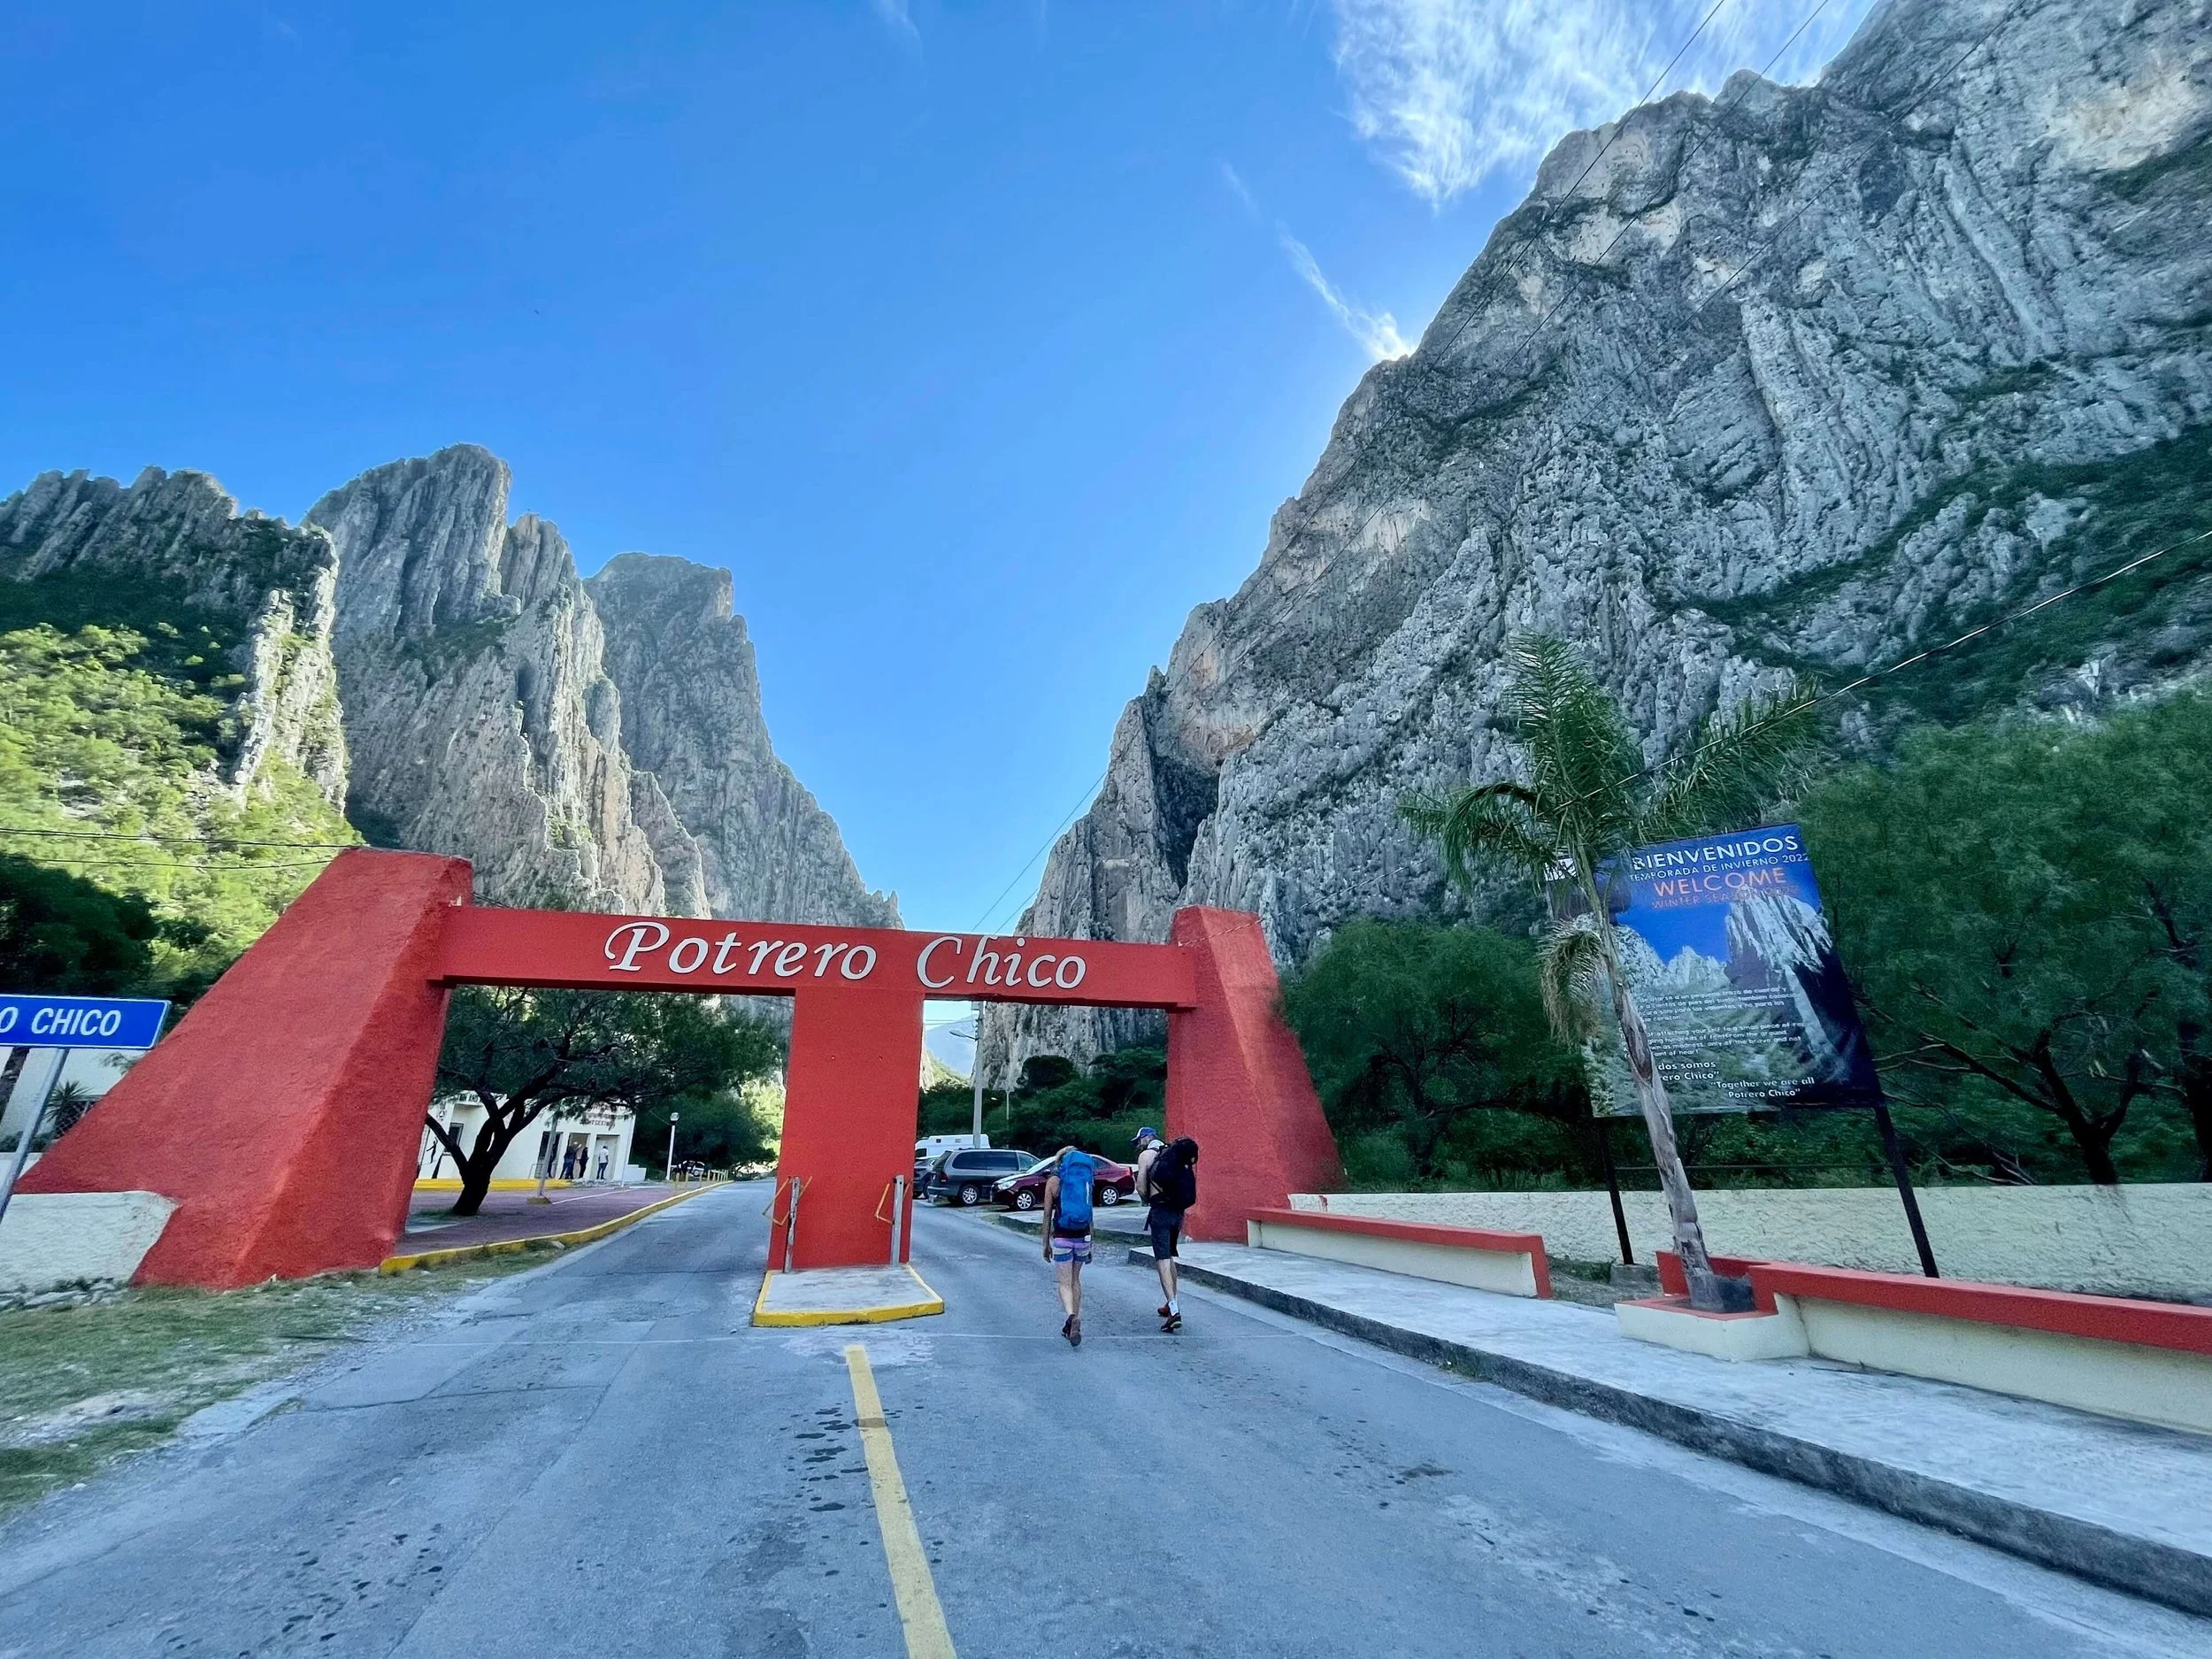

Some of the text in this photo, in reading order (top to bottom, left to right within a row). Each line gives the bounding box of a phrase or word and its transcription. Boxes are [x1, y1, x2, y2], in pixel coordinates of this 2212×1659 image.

[1632, 835, 1798, 871] BIENVENIDOS
[1629, 866, 1699, 882] TEMPORADA
[1702, 864, 1717, 873] DE
[1720, 856, 1778, 872] INVIERNO
[1654, 866, 1786, 897] WELCOME
[1652, 895, 1700, 909] WINTER
[603, 920, 1087, 990] Potrero Chico
[31, 1007, 122, 1037] CHICO
[1728, 1090, 1765, 1099] Potrero
[1801, 1076, 1815, 1085] all
